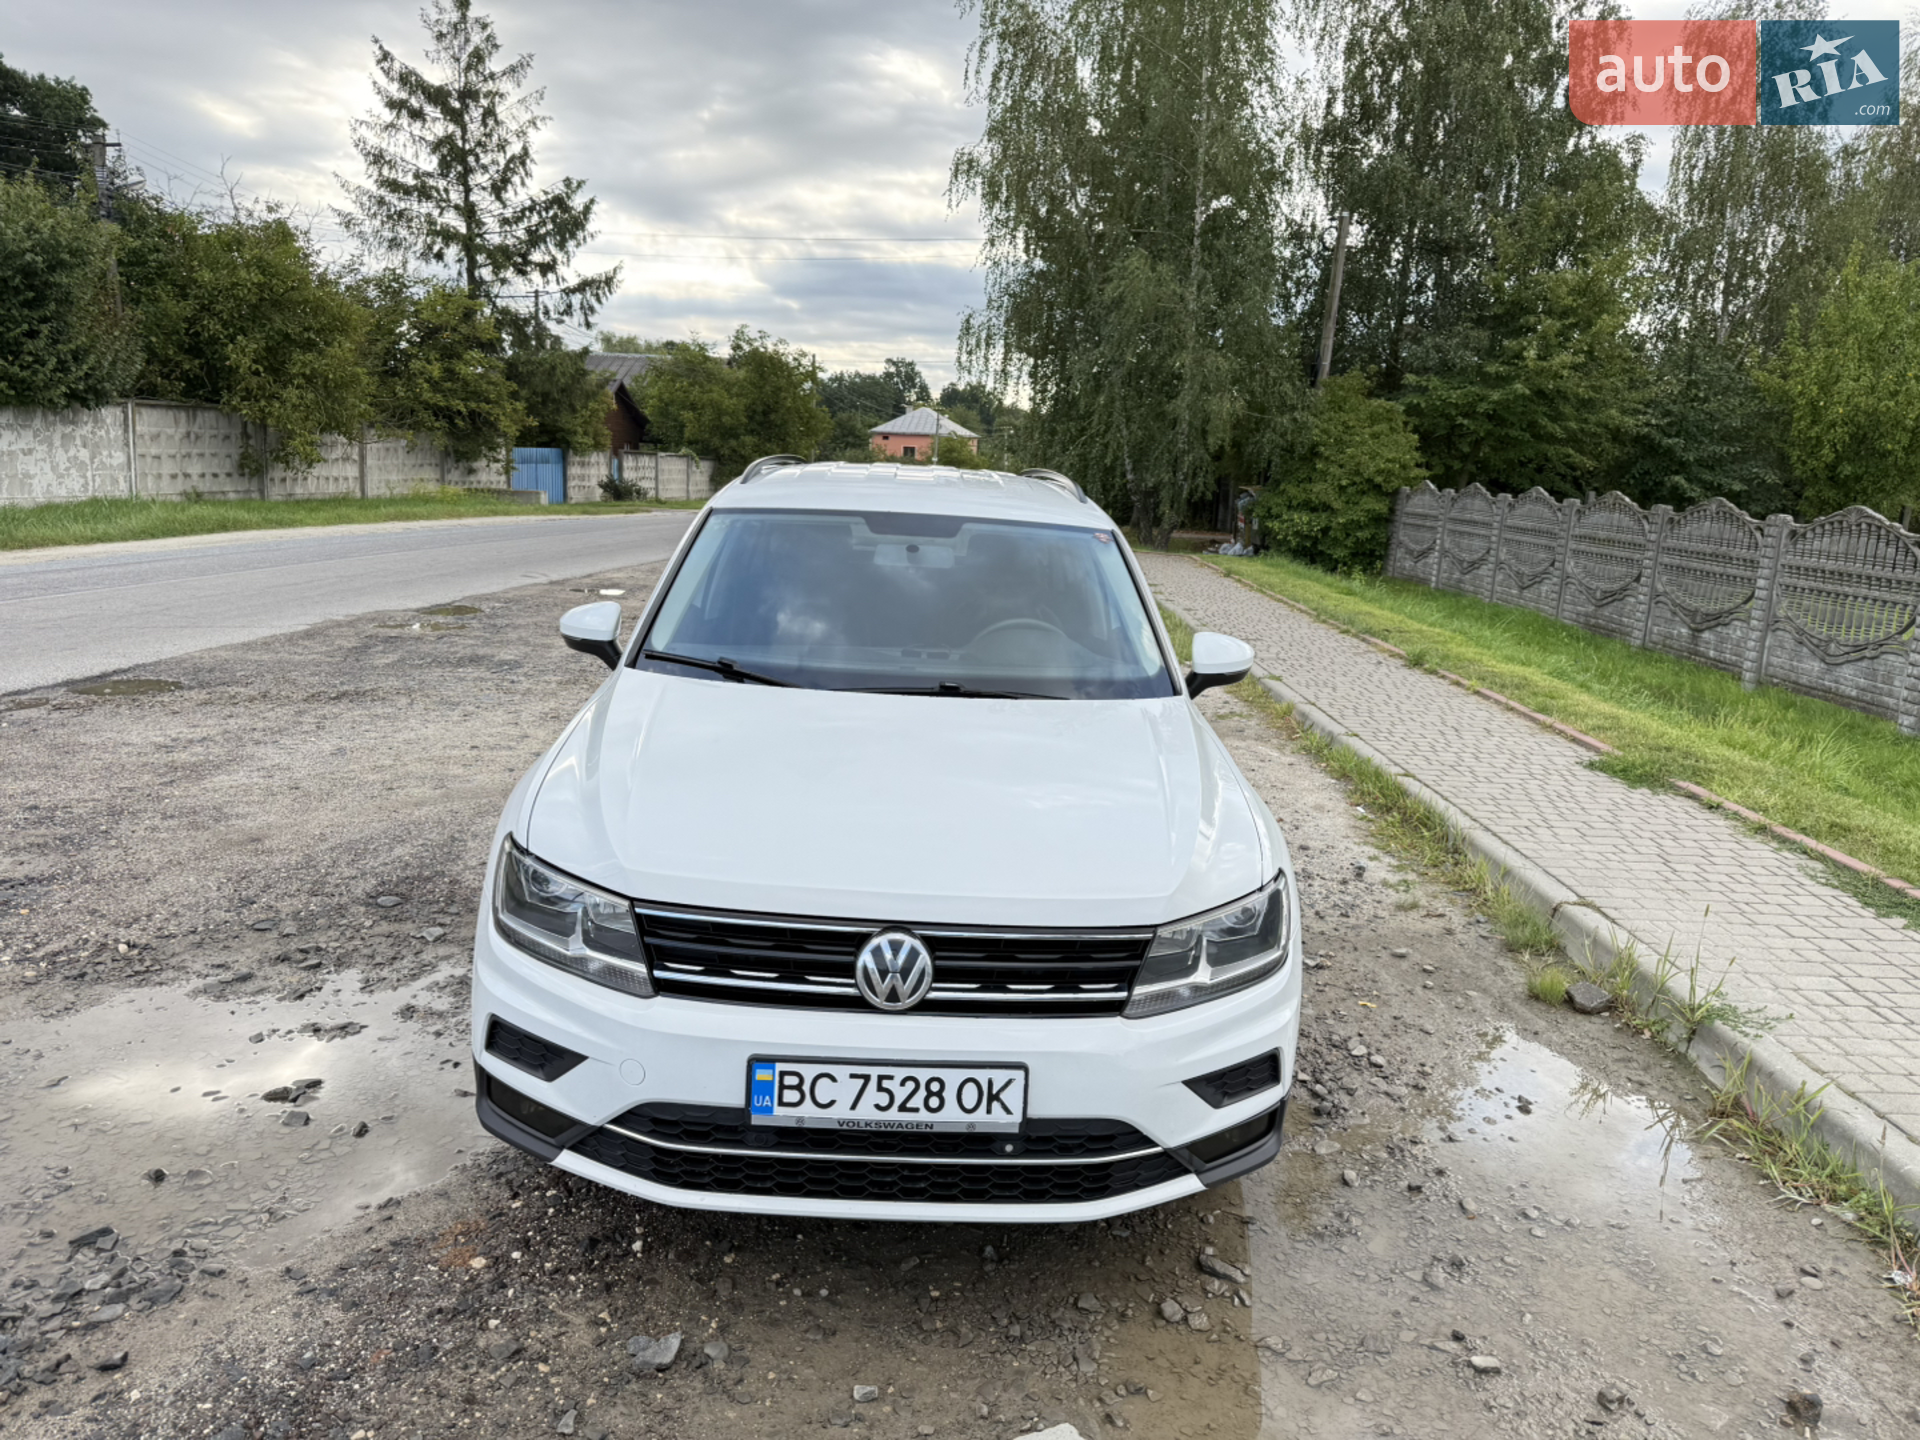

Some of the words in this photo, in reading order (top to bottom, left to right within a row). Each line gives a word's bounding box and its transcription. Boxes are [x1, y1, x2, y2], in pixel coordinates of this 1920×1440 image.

[777, 1070, 838, 1110] BC
[848, 1073, 946, 1114] 7528
[956, 1076, 1016, 1116] OK
[754, 1095, 773, 1107] UA
[837, 1120, 934, 1130] VOLKSWAGEN
